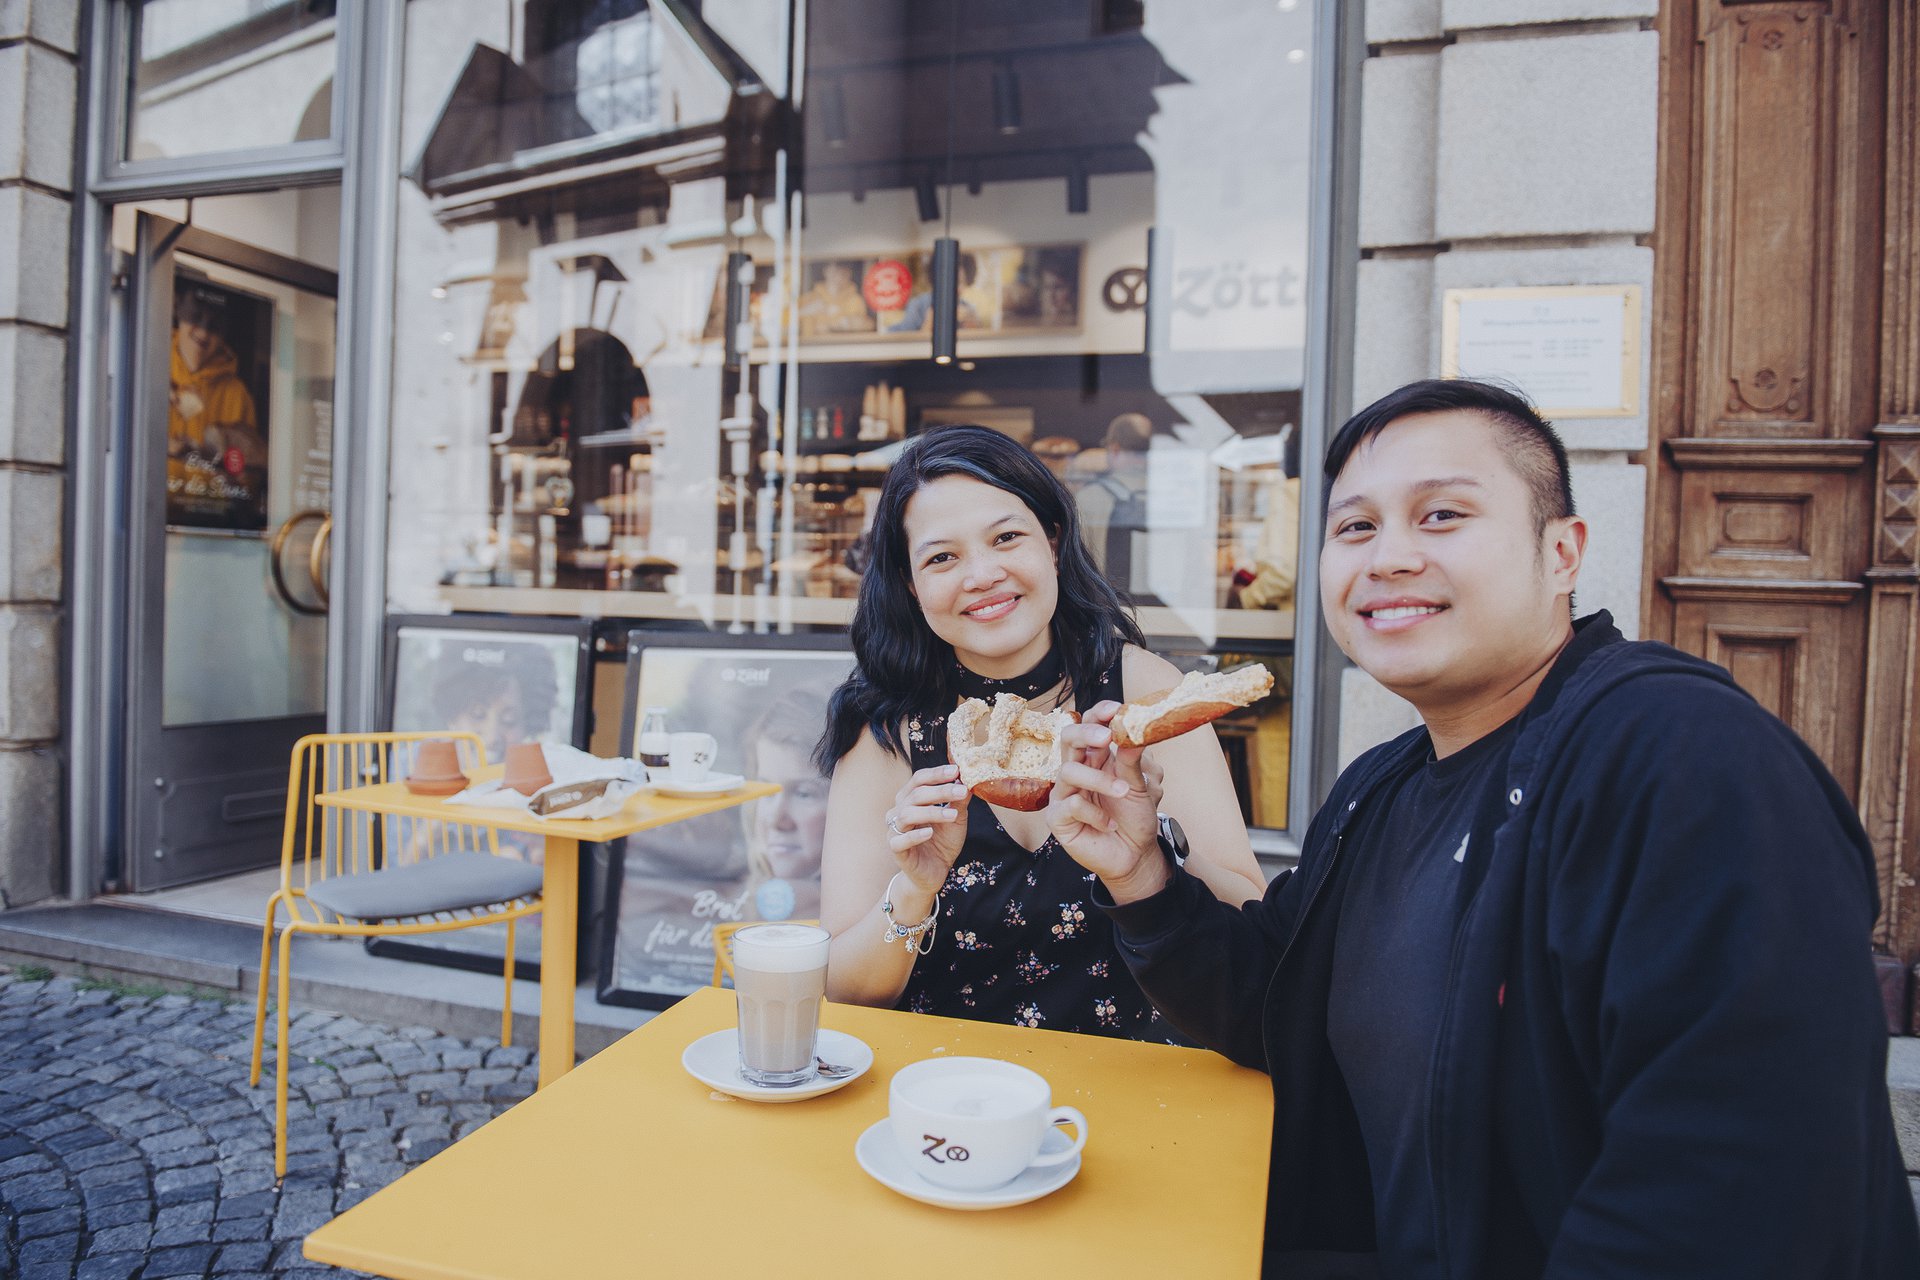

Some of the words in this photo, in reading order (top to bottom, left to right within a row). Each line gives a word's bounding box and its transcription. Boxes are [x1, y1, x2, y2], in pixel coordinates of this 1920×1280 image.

[1175, 261, 1303, 320] Zött
[691, 889, 750, 921] Brot
[644, 919, 690, 953] für
